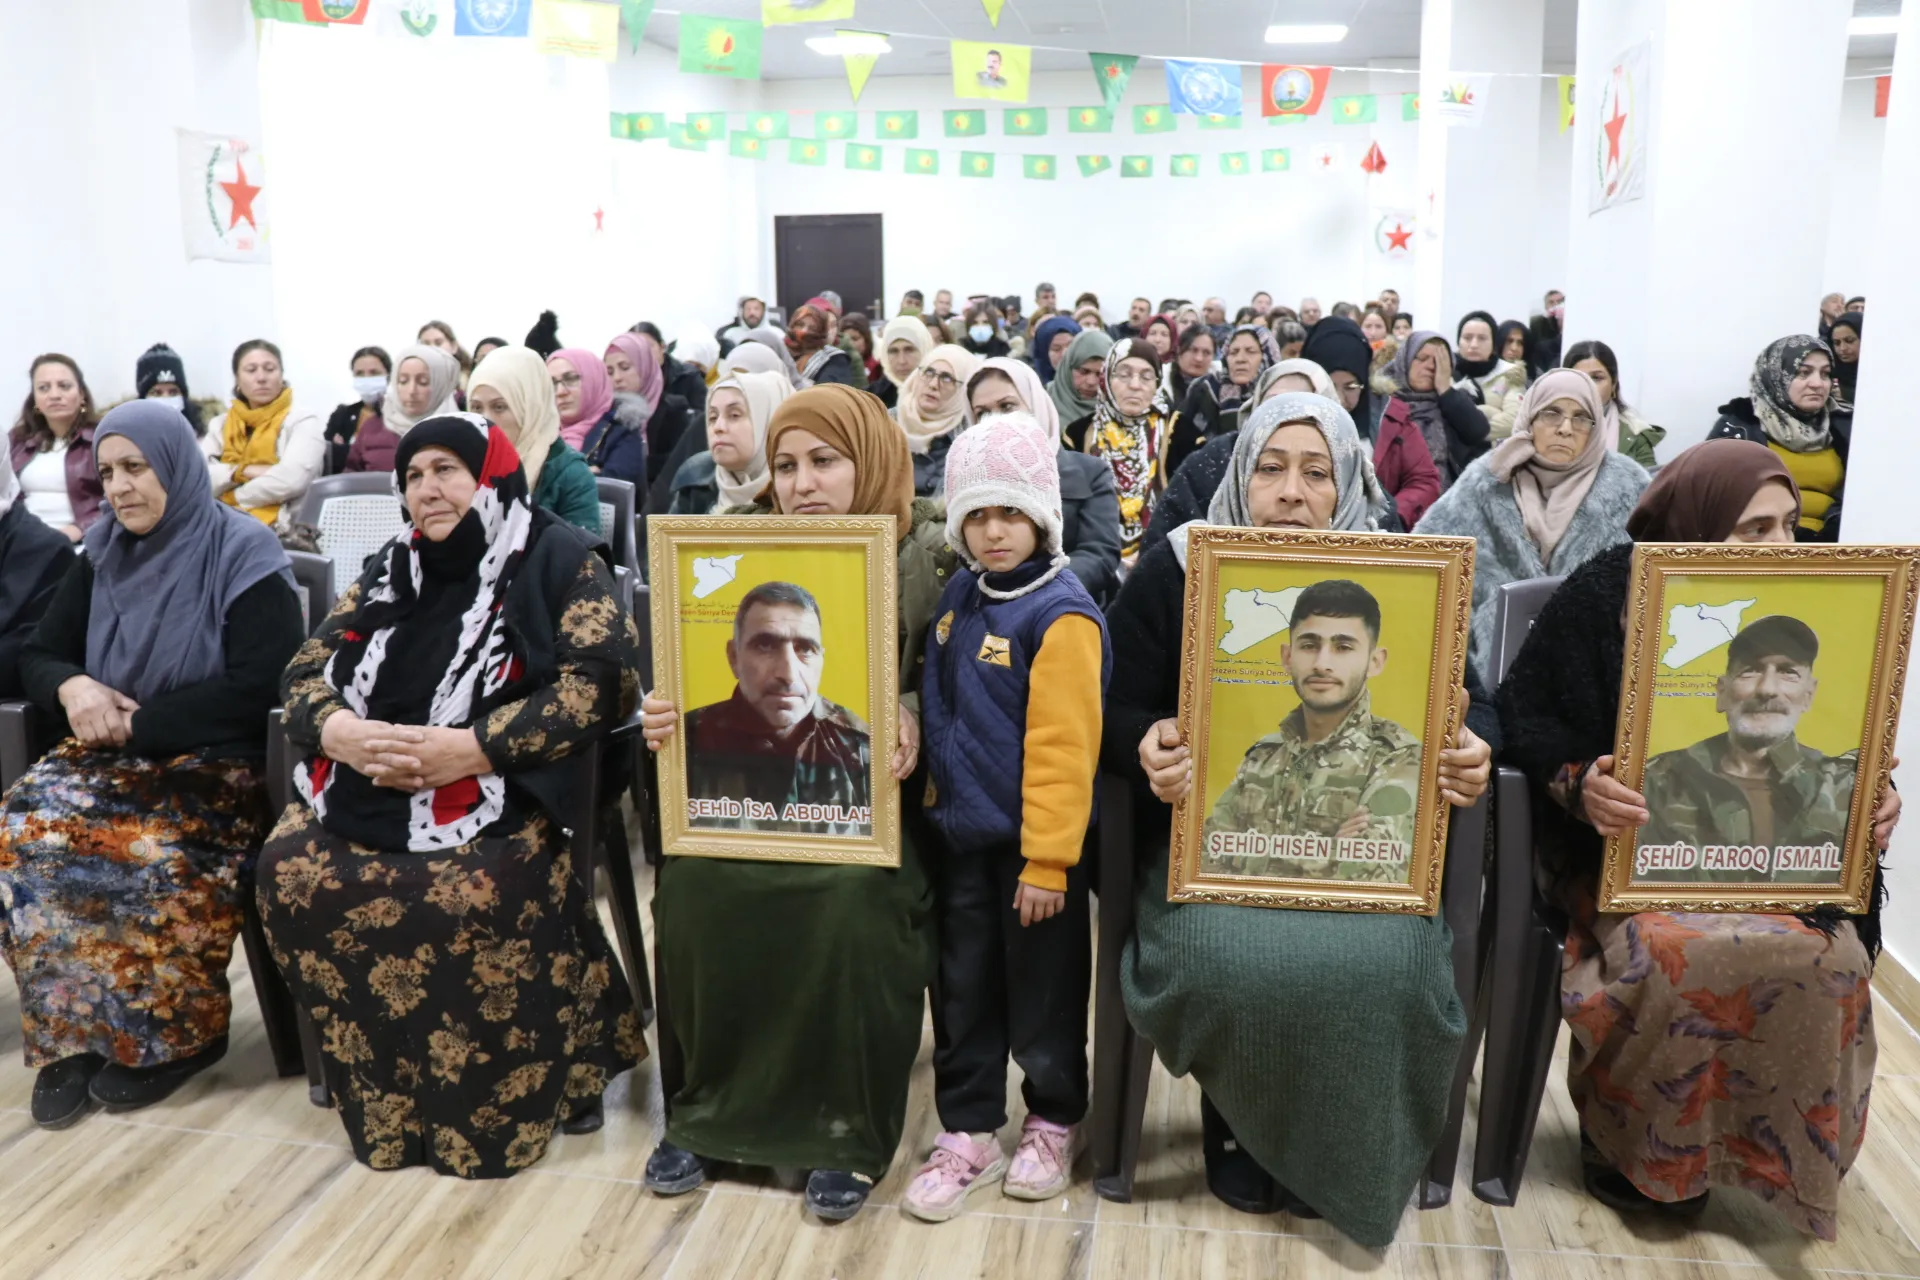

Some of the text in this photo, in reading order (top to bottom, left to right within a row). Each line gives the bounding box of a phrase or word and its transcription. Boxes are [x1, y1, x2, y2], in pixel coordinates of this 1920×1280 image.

[688, 797, 872, 823] ŞEHÎD ÎSA ABDULAH
[1210, 831, 1403, 861] ŞEHÎD HISÊN HESEN
[1638, 843, 1840, 872] ŞEHÎD FAROQ ISMAÎL
